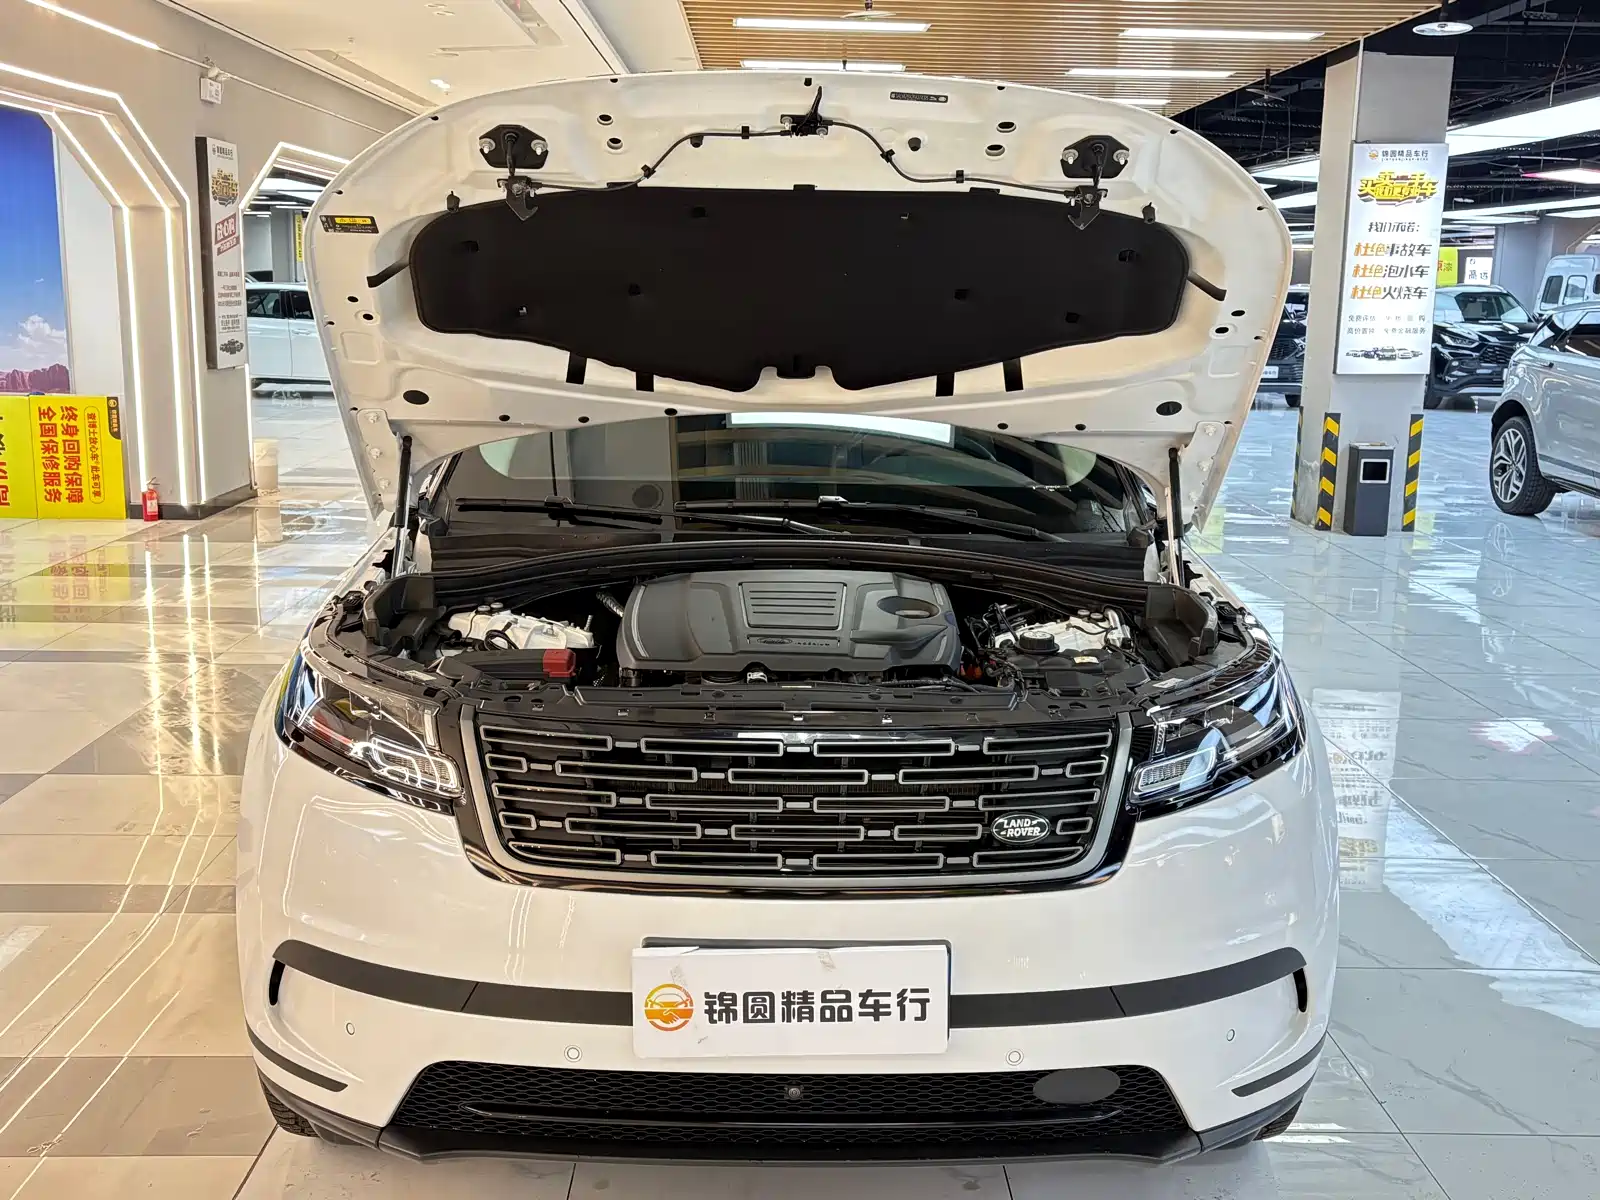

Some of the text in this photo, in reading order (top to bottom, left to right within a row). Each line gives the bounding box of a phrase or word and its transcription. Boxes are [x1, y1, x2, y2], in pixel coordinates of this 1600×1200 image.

[1353, 242, 1432, 257] 杜绝事故车
[1352, 263, 1430, 279] 杜绝泡水车
[1350, 285, 1428, 300] 杜绝火烧车
[38, 406, 62, 503] 全国保修服务
[60, 406, 84, 504] 终身回购保障
[1003, 818, 1031, 829] LAND
[1006, 827, 1041, 838] ROVER
[703, 988, 931, 1025] 锦圆精品车行
